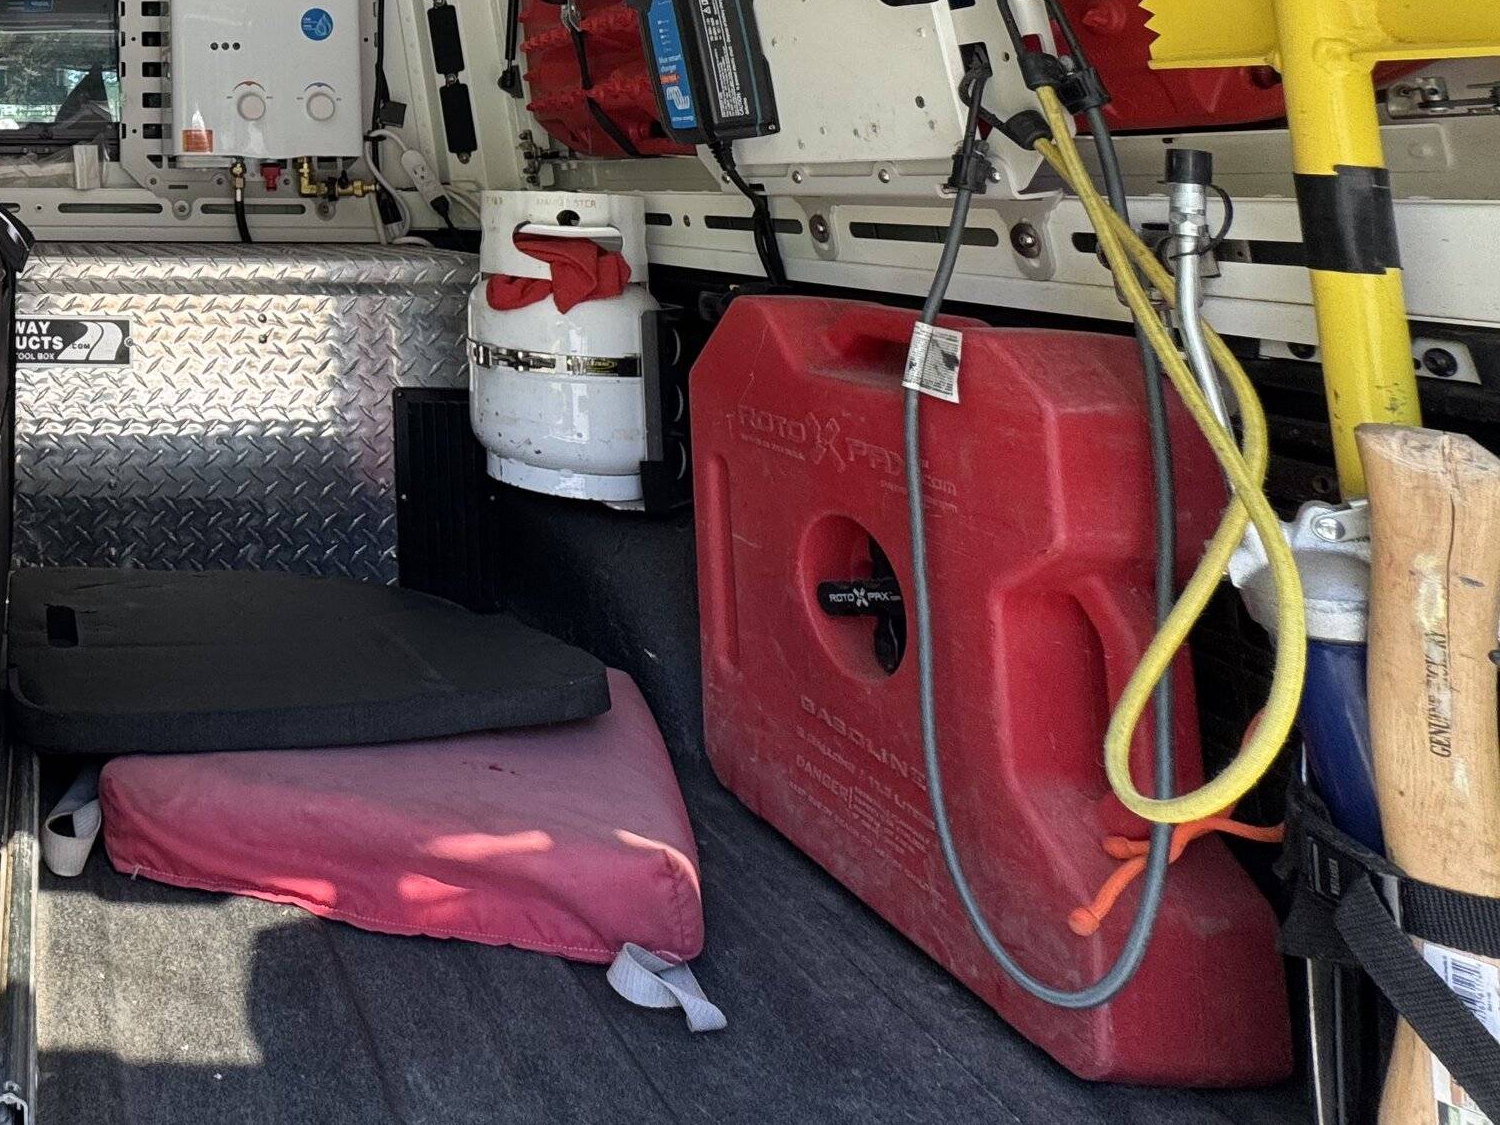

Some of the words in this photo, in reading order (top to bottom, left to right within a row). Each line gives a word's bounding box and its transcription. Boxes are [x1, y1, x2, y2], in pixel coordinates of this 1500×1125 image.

[15, 321, 51, 334] WAY
[15, 335, 64, 350] UCTS
[16, 352, 36, 360] OOL
[37, 352, 56, 360] BOX
[795, 753, 850, 803] DANGER
